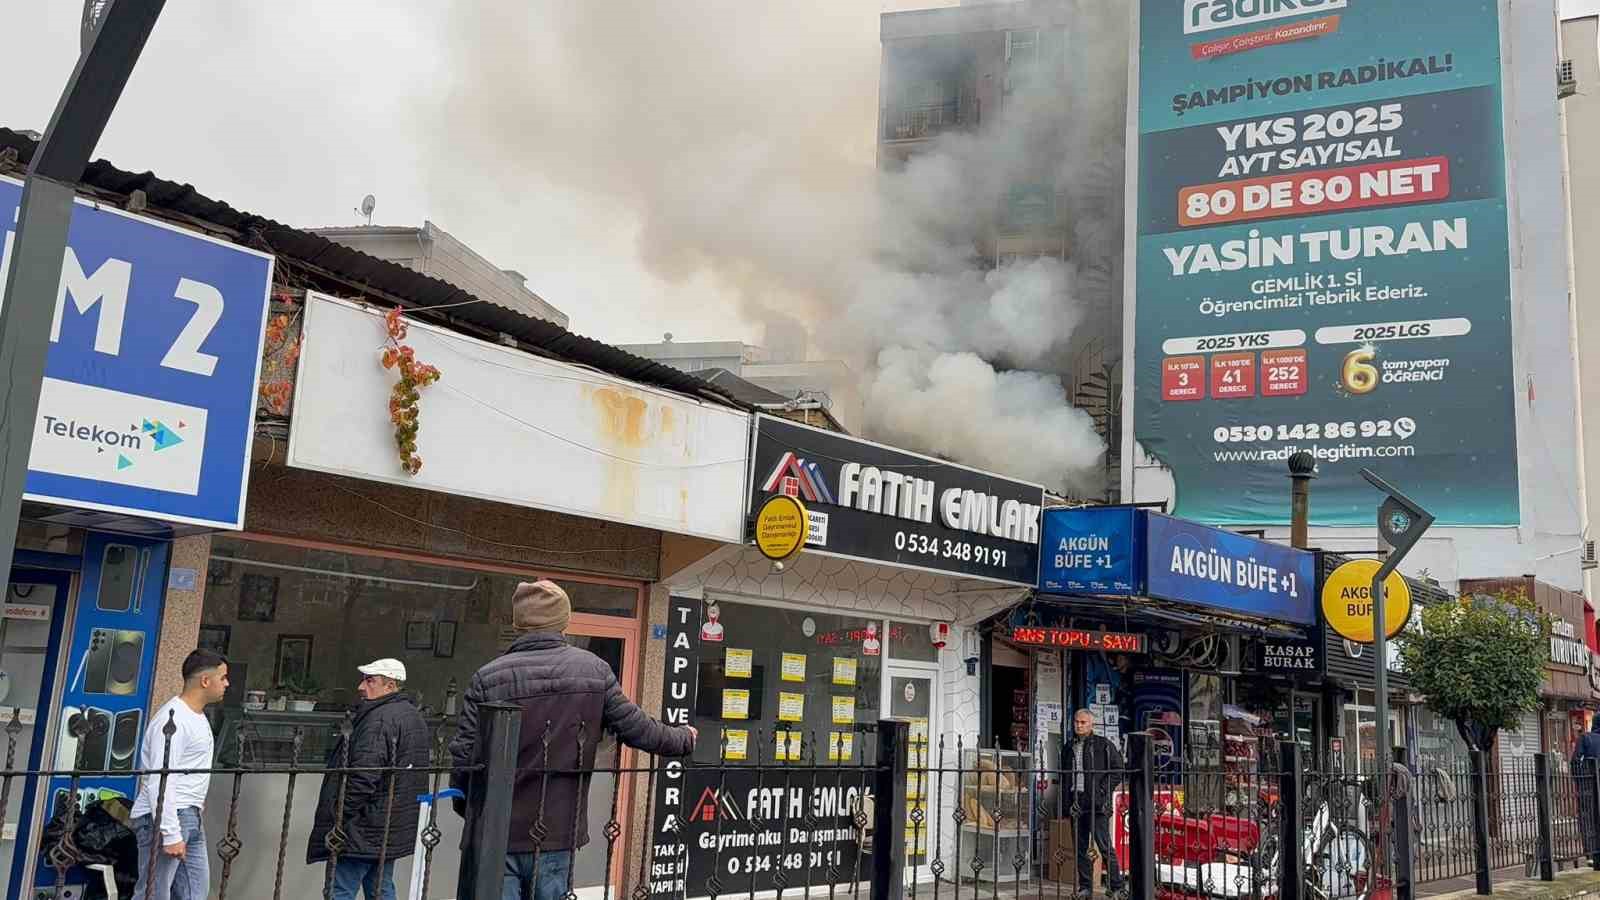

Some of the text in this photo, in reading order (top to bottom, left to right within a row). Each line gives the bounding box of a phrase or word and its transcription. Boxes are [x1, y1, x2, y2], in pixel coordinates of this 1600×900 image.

[1172, 53, 1453, 117] ŞAMPİYON RADİKAL!
[1217, 104, 1402, 151] YKS 2025
[1218, 137, 1401, 177] AYT SAYISAL
[1186, 165, 1441, 218] 80 DE 80 NET
[1163, 218, 1468, 276] YASİN TURAN
[1252, 268, 1362, 295] GEMLİK 1. Sİ
[1199, 284, 1428, 317] Öğrencimizi Tebrik Ederiz.
[160, 277, 224, 377] 2
[1354, 323, 1430, 340] 2025 LGS
[1196, 333, 1270, 350] 2025 YKS
[1268, 366, 1299, 381] 252
[1342, 348, 1379, 394] 6
[1382, 357, 1449, 374] tam yapan
[1382, 366, 1444, 384] ÖĞRENCİ
[1179, 372, 1189, 386] 3
[1222, 369, 1241, 384] 41
[1218, 385, 1247, 393] DERECE
[1269, 382, 1298, 391] DERECE
[43, 416, 141, 449] Telekom
[1214, 420, 1392, 443] 0530 142 86 92
[838, 463, 1041, 545] FATİH EMLAK
[895, 531, 905, 550] 0
[908, 533, 939, 556] 534
[943, 539, 971, 562] 348
[1059, 534, 1108, 551] AKGÜN
[1054, 551, 1112, 569] BÜFE +1
[1170, 545, 1298, 597] AKGÜN BÜFE +1
[1347, 600, 1373, 616] BÜF
[1050, 629, 1090, 648] TOPU
[671, 607, 691, 699] TAPU
[1265, 645, 1314, 658] KASAP
[1264, 656, 1315, 669] BURAK
[667, 708, 689, 723] VE
[747, 787, 803, 820] FATH
[654, 843, 685, 857] TAKP
[699, 828, 782, 853] Gayrimenku
[728, 857, 739, 874] 0
